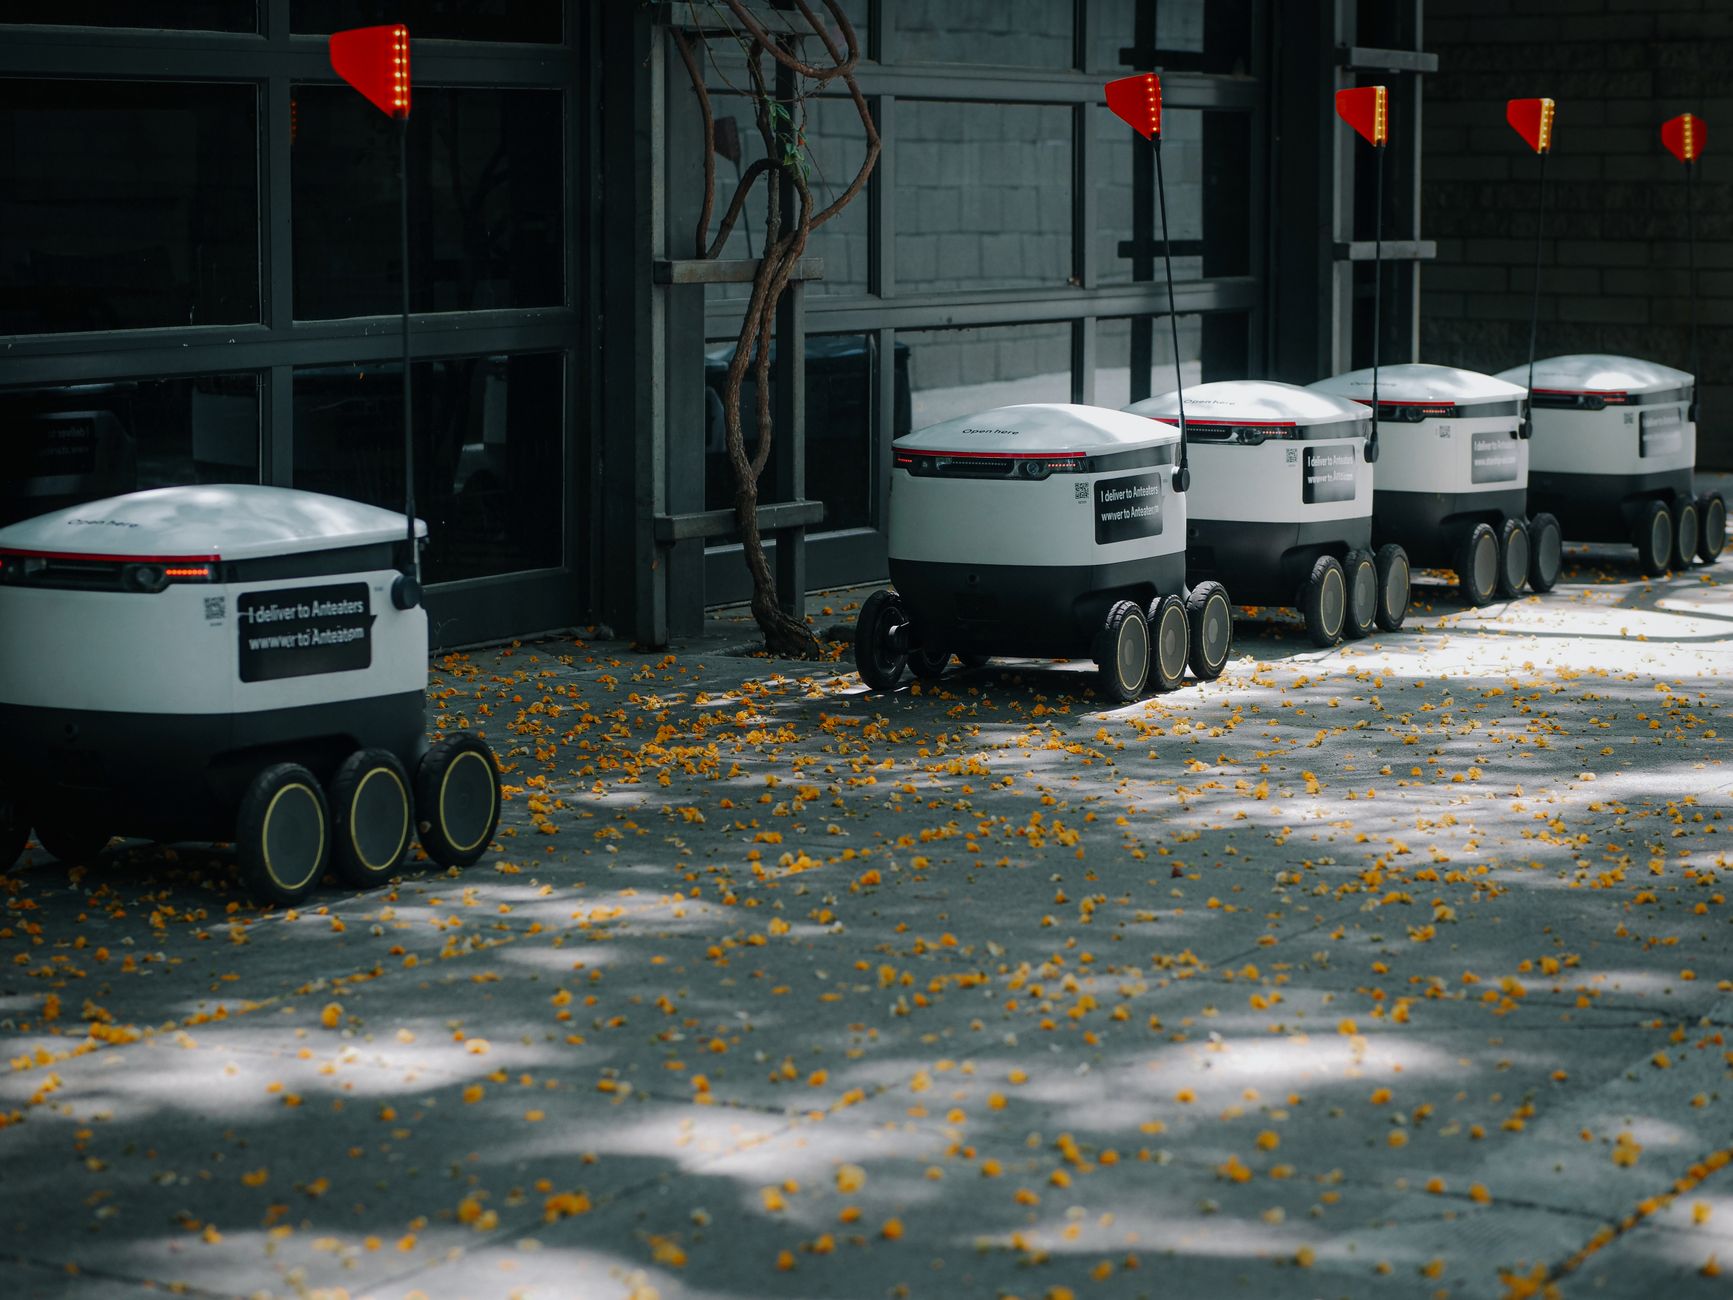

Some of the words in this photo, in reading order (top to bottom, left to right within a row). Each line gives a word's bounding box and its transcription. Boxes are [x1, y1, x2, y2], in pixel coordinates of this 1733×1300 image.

[1100, 490, 1104, 503] I
[1104, 488, 1125, 502] deliver
[1125, 488, 1133, 499] to
[1133, 485, 1159, 498] Anteaters
[1123, 508, 1131, 519] to
[248, 606, 254, 624] I
[255, 604, 296, 623] deliver
[297, 602, 311, 619] to
[311, 599, 364, 617] Anteaters
[297, 630, 311, 647] to
